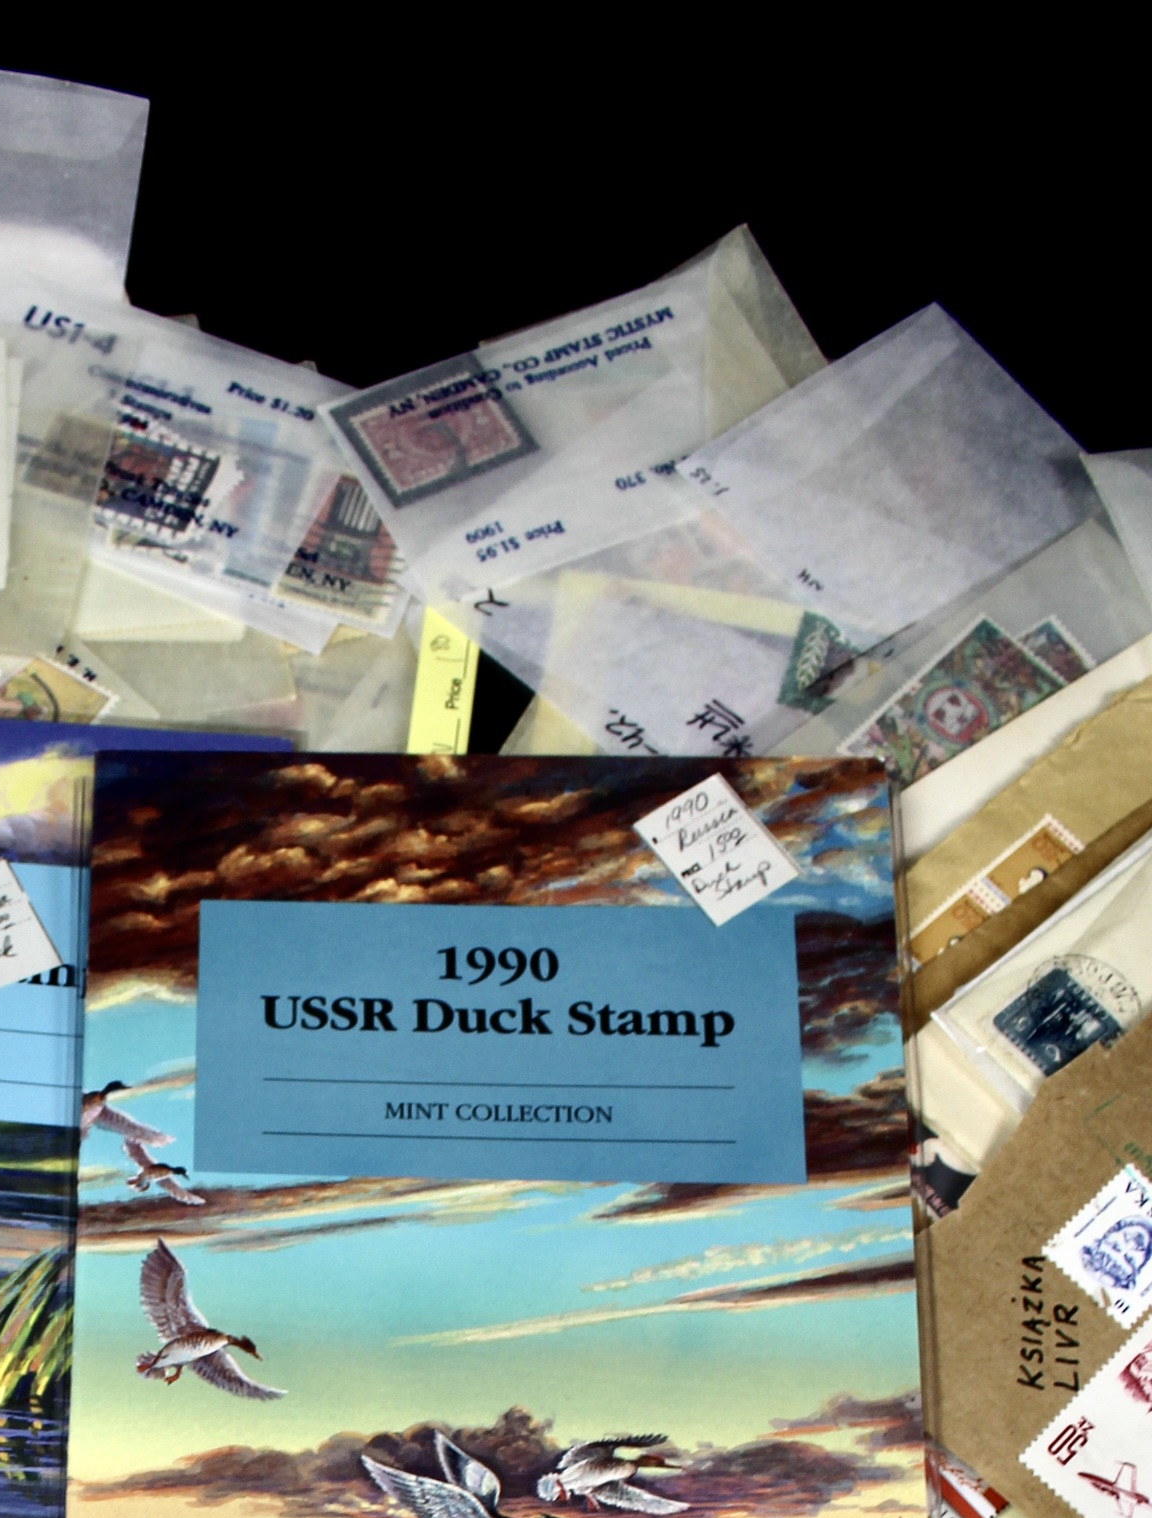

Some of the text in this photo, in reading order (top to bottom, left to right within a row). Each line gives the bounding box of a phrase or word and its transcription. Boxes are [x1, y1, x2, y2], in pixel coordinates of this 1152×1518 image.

[24, 304, 118, 356] US1-4
[605, 305, 675, 342] MYSTIC
[543, 332, 603, 366] STAMP
[604, 336, 652, 362] Priced
[524, 354, 600, 385] According
[227, 381, 267, 405] Price
[505, 380, 522, 393] to
[388, 396, 417, 419] NY
[614, 471, 647, 491] 370
[209, 519, 240, 539] NY
[464, 520, 504, 545] 1909
[476, 519, 567, 564] Price $1.95
[321, 573, 352, 592] NY
[445, 678, 462, 711] Price
[665, 791, 709, 829] 1990
[436, 946, 559, 986] 1990
[260, 995, 736, 1048] USSR Duck Stamp
[384, 1100, 614, 1125] MINT COLLECTION
[1011, 1255, 1051, 1390] KSIĄŻKA
[1053, 1303, 1080, 1392] LIVR
[1047, 1424, 1089, 1467] 50
